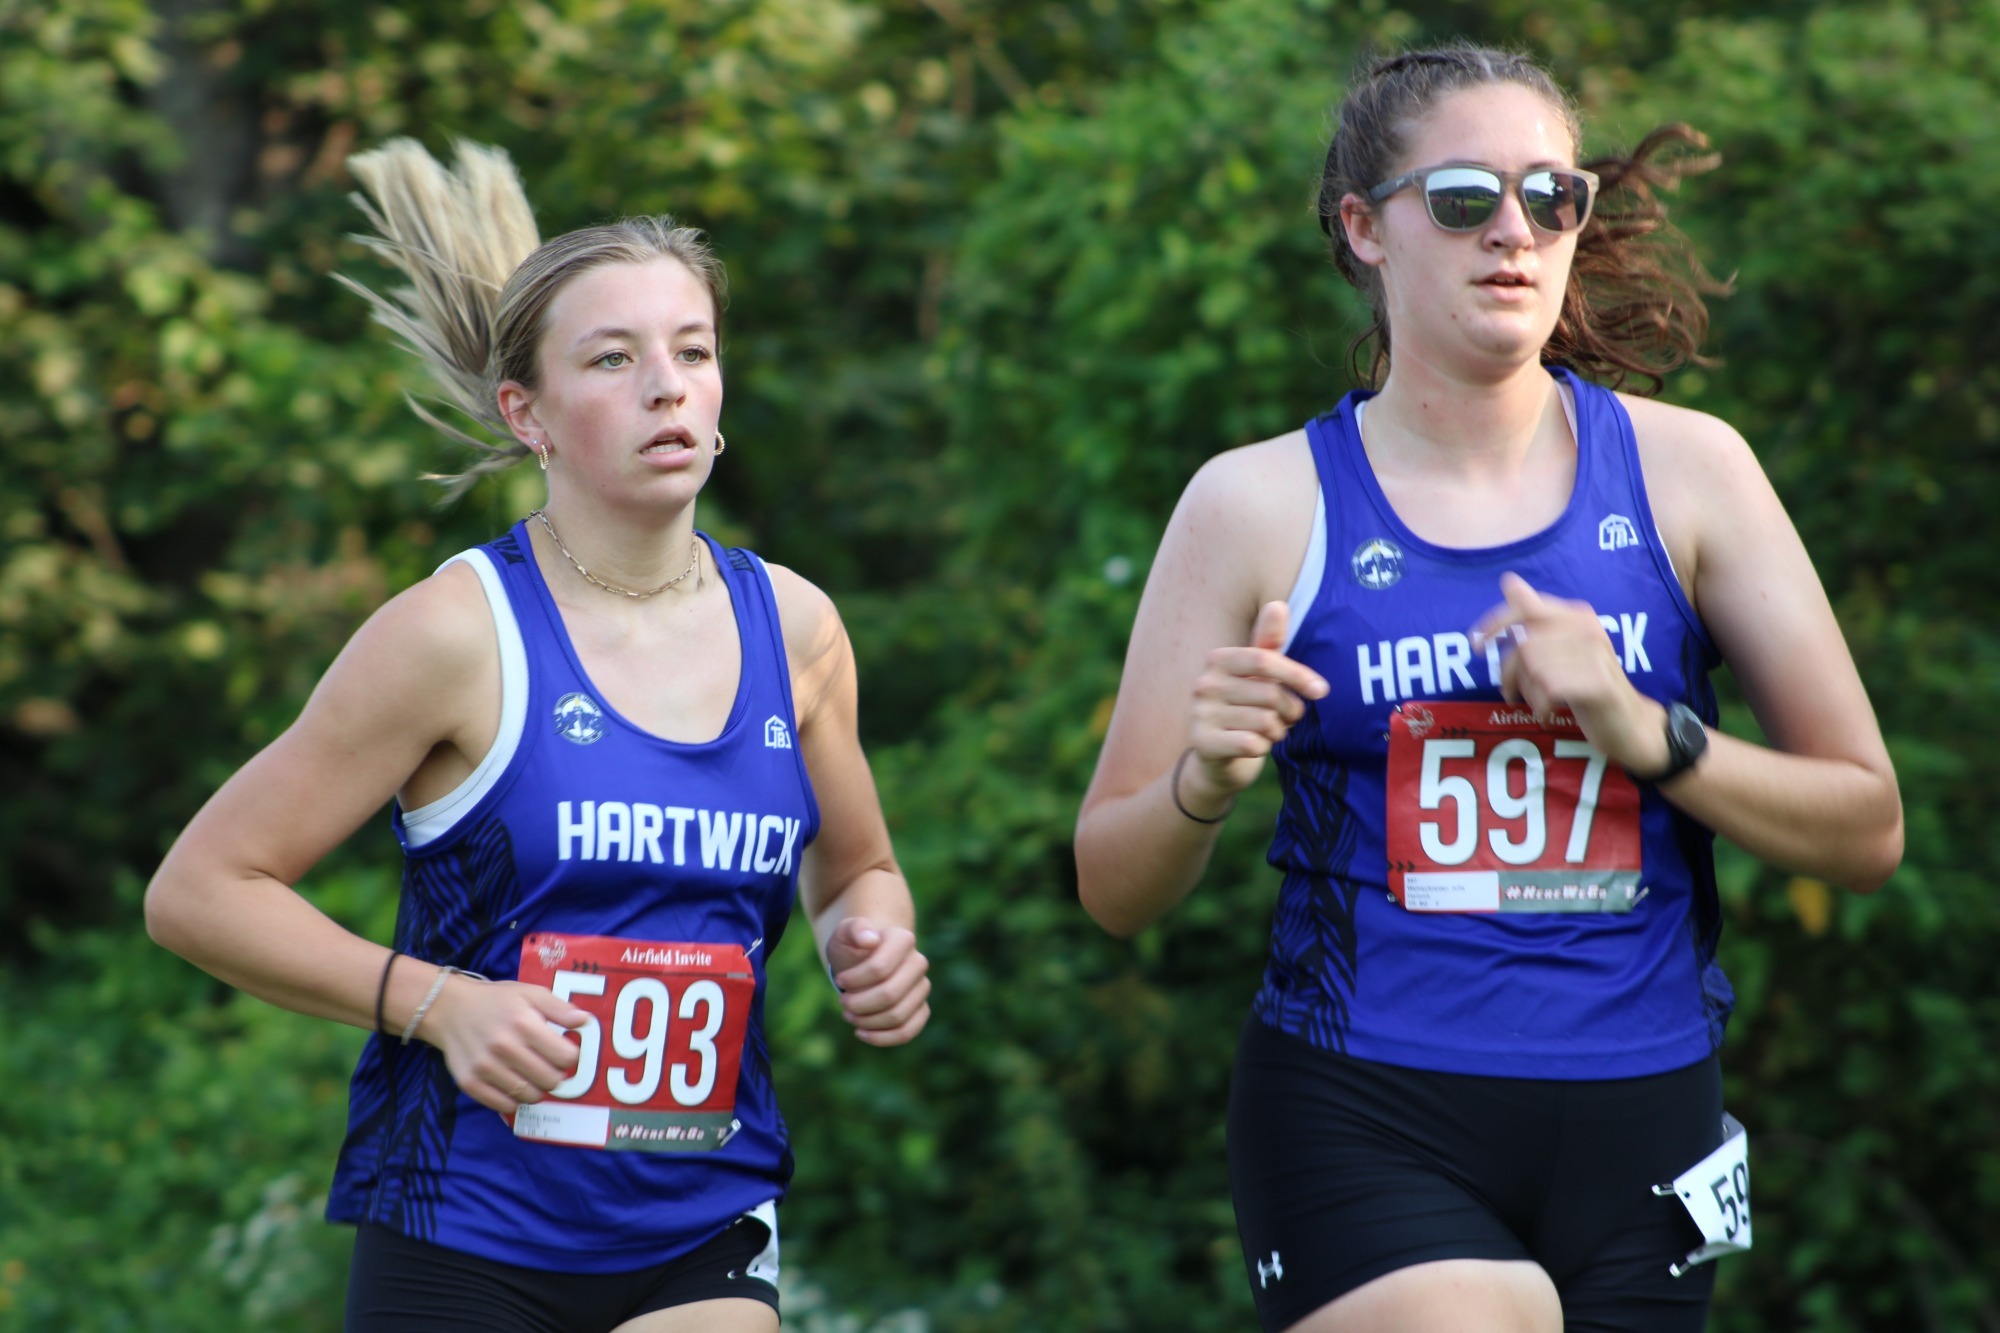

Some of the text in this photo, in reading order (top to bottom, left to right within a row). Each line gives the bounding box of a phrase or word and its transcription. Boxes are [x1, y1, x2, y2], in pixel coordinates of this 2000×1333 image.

[1357, 611, 1653, 705] HARTK
[557, 800, 801, 876] HARTWICK
[1419, 738, 1608, 866] 597
[620, 946, 712, 966] Airfield Invite
[547, 969, 725, 1106] 593
